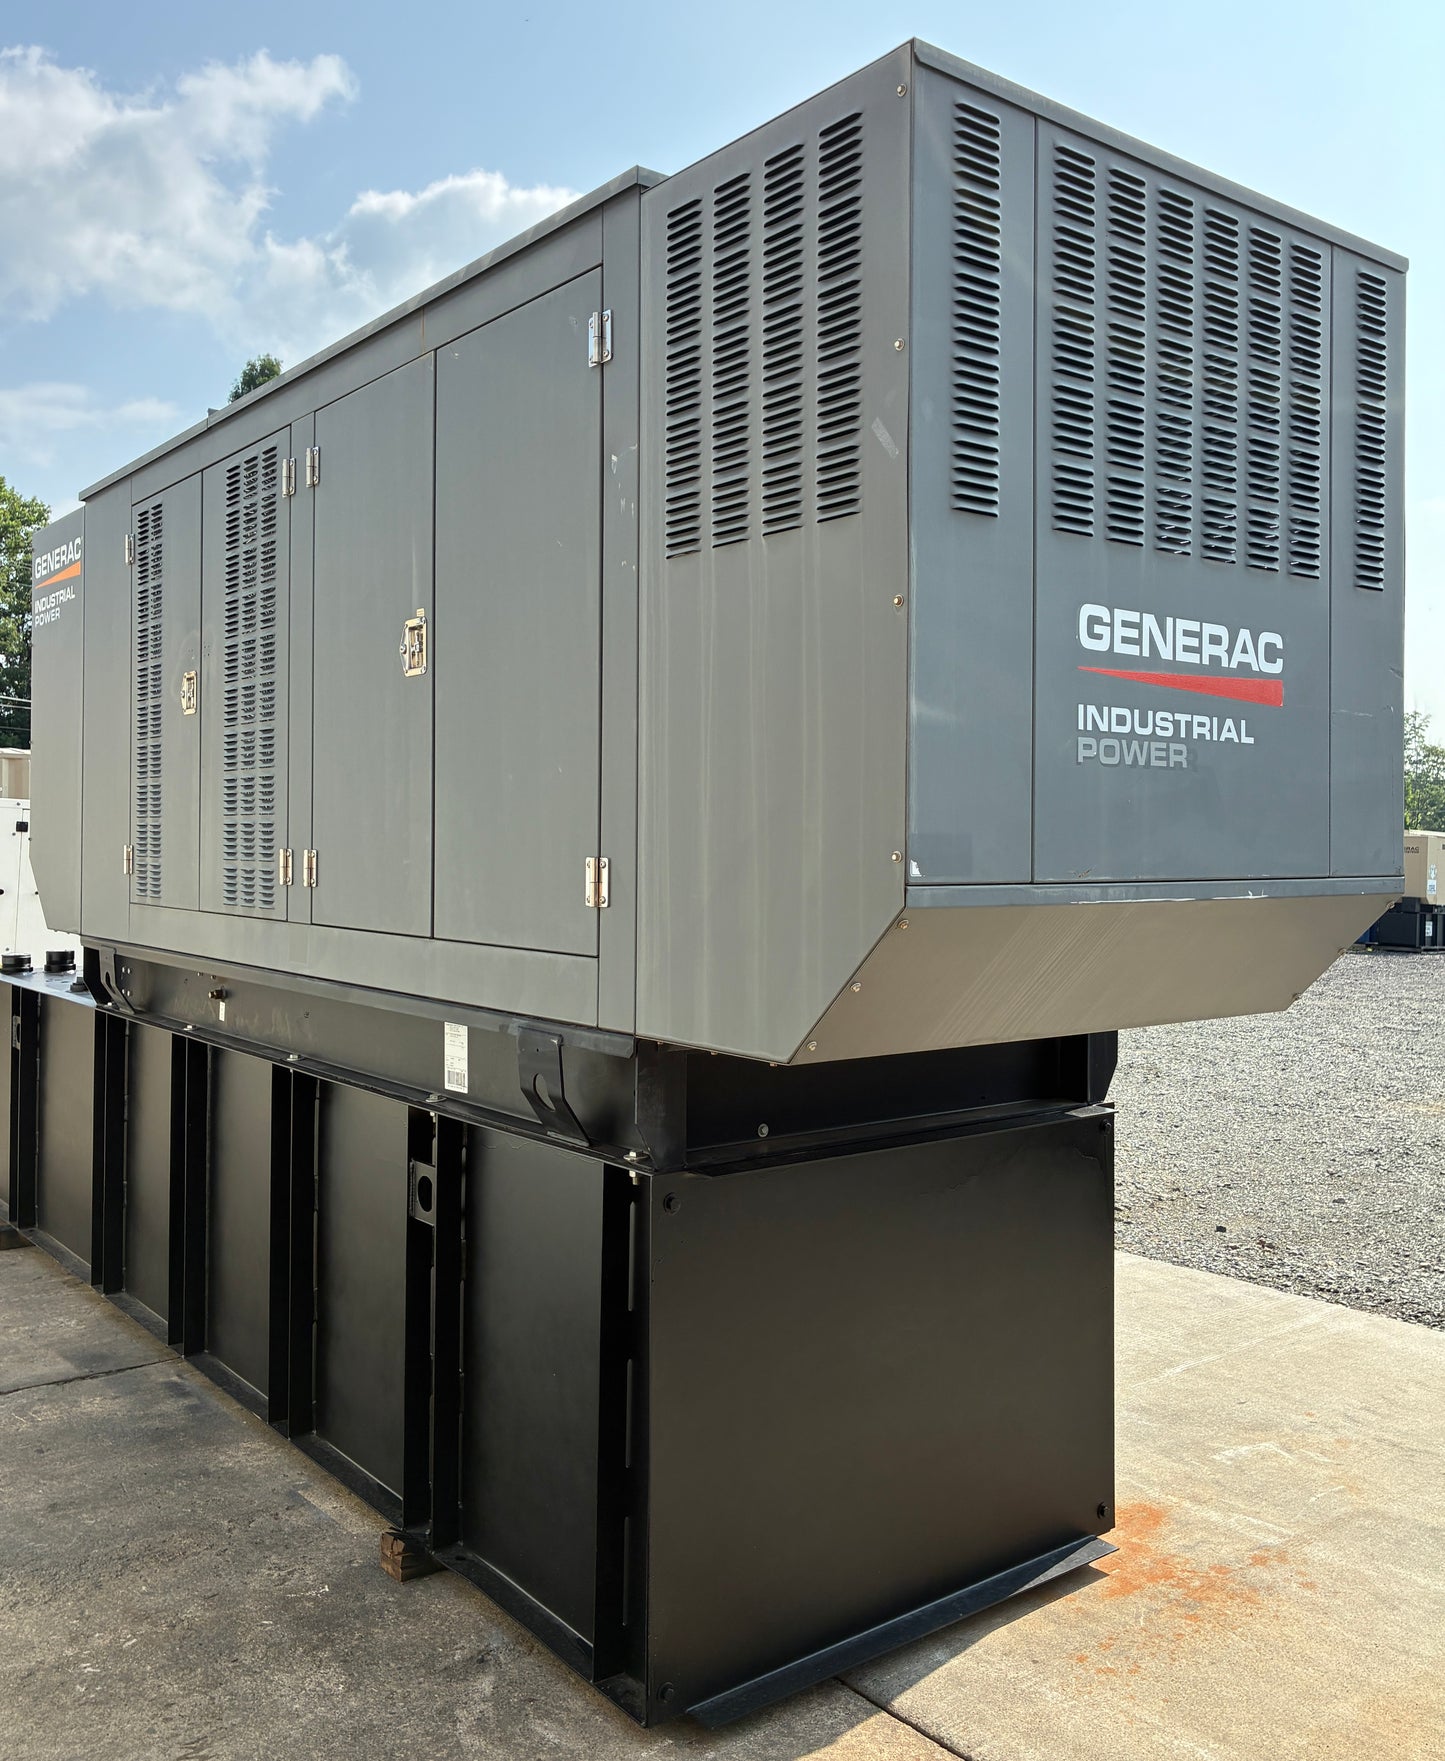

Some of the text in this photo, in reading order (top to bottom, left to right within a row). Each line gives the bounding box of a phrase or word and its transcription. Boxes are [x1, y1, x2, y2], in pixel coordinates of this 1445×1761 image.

[35, 537, 81, 579] GENERAC
[35, 585, 75, 614] INDUSTRIAL
[35, 607, 60, 627] POWER
[1079, 603, 1284, 674] GENERAC
[1077, 704, 1255, 744] INDUSTRIAL
[1077, 737, 1188, 768] POWER
